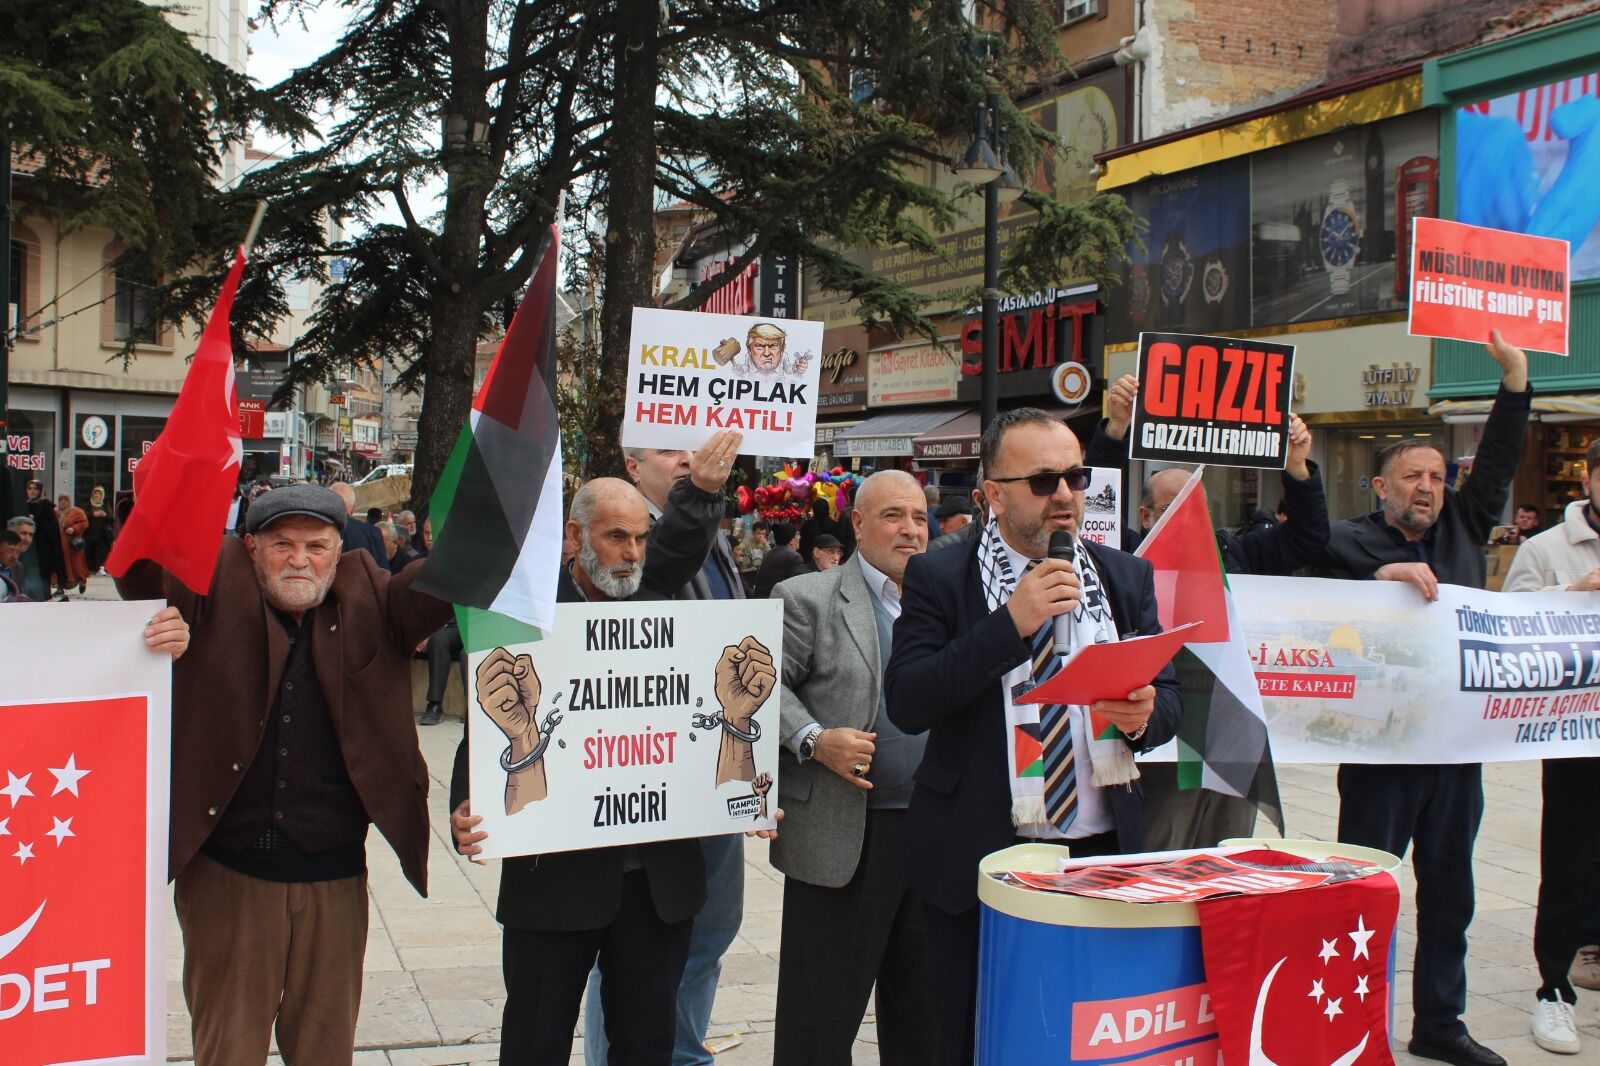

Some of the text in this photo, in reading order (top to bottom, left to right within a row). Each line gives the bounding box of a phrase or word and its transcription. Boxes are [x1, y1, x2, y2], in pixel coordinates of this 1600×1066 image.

[1419, 246, 1564, 292] MÜSLÜMAN UYUMA
[1415, 276, 1563, 324] FİLİSTİNE SAHİP ÇIK
[640, 343, 716, 370] KRAL
[893, 351, 918, 373] Gayret
[638, 373, 700, 397] HEM
[708, 377, 808, 406] ÇIPLAK
[1143, 342, 1285, 425] GAZZE
[636, 401, 698, 426] HEM
[923, 443, 962, 456] KASTAMONU
[1141, 421, 1281, 457] GAZZELİLERİNDİR
[1084, 520, 1116, 533] ÇOCUK
[586, 617, 675, 651] KIRILSIN
[1455, 605, 1547, 636] TÜRKİYE'DEKİ
[1273, 648, 1335, 668] AKSA
[1464, 643, 1583, 689] MESCİD-İ
[569, 666, 690, 711] ZALİMLERİN
[1292, 679, 1353, 694] KAPALI!
[1483, 694, 1548, 720] İBADETE
[583, 726, 678, 770] SİYONİST
[1515, 721, 1557, 743] TALEP
[593, 782, 667, 828] ZİNCİRİ
[730, 798, 761, 810] KAMPÜS
[0, 958, 111, 1021] DET
